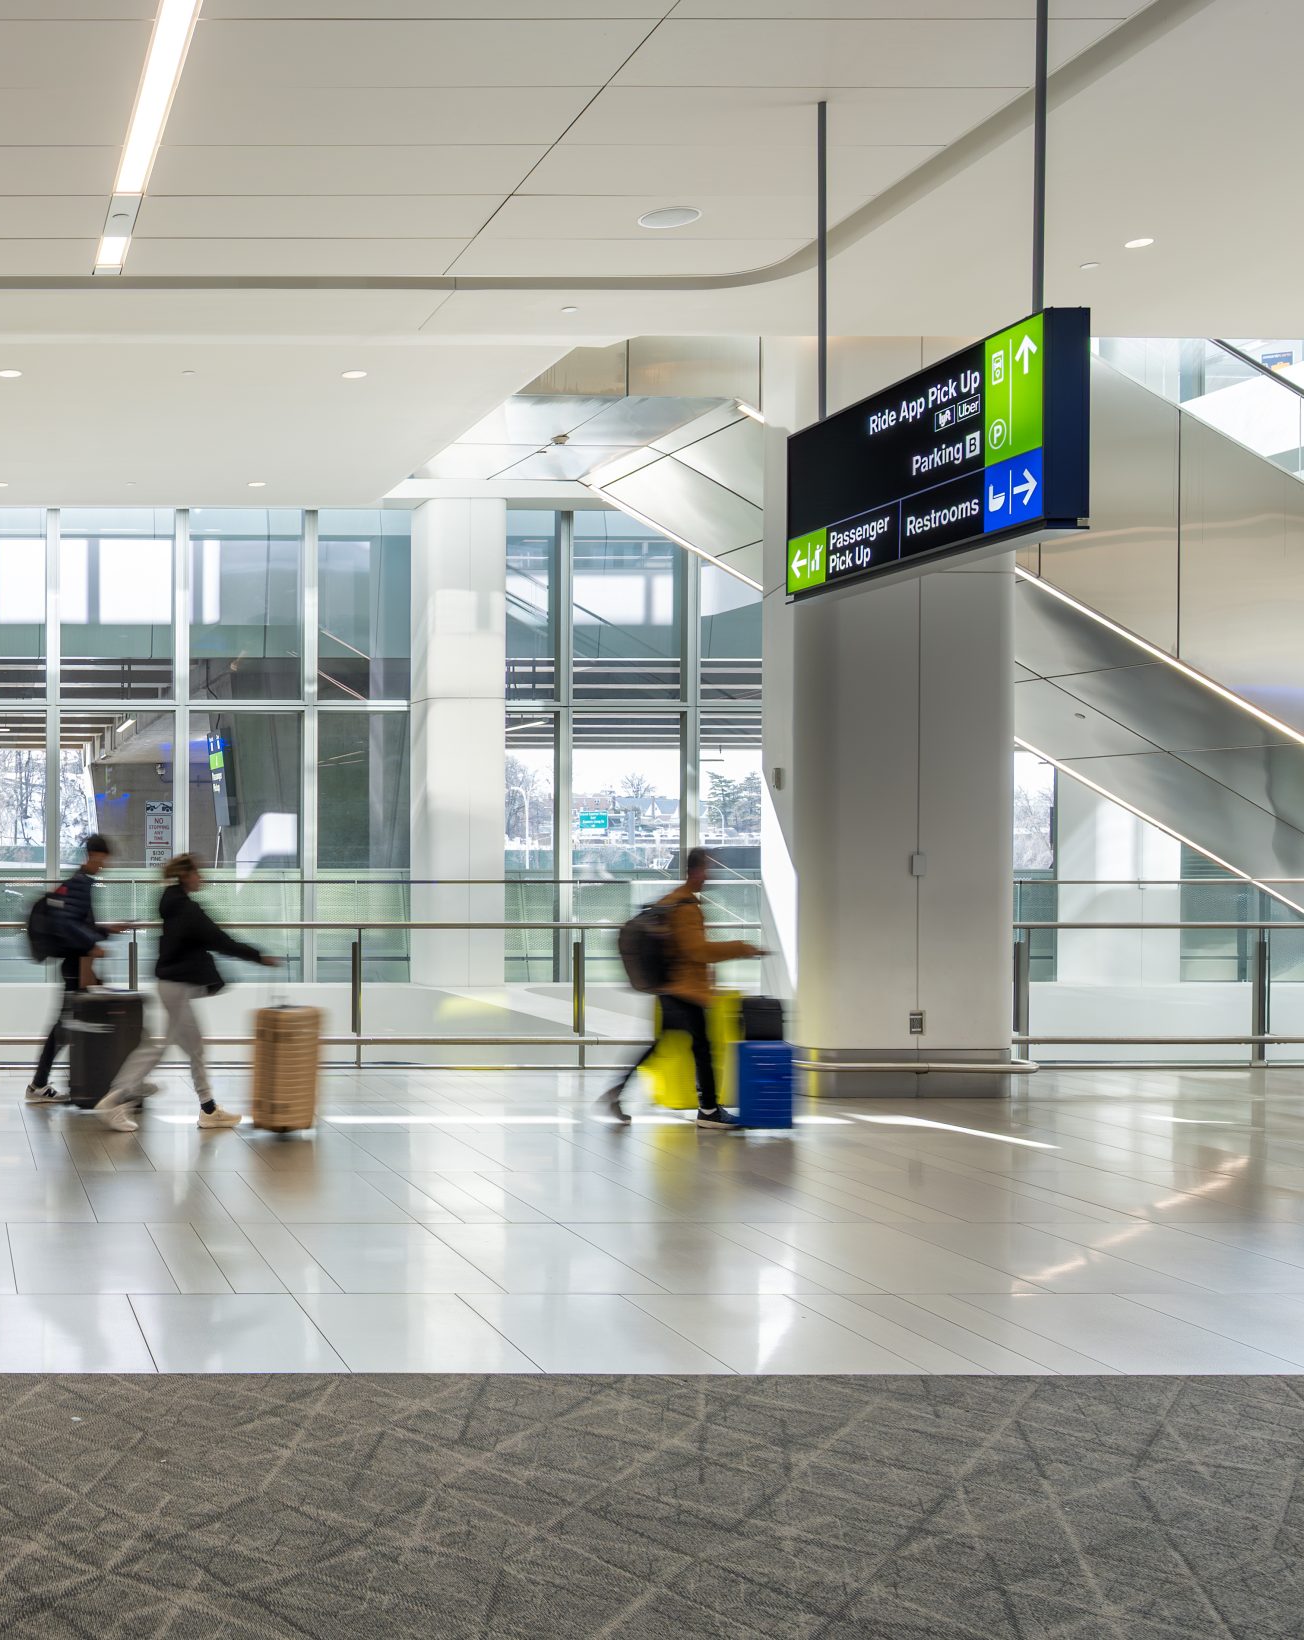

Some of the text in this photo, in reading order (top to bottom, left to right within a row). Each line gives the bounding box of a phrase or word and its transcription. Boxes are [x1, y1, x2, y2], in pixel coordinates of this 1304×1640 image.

[869, 370, 980, 435] Ride App Pick Up
[938, 400, 979, 428] lyft Uber
[912, 436, 977, 476] Parking B
[829, 515, 890, 550] Passenger
[906, 498, 979, 537] Restrooms
[829, 546, 871, 574] Pick Up
